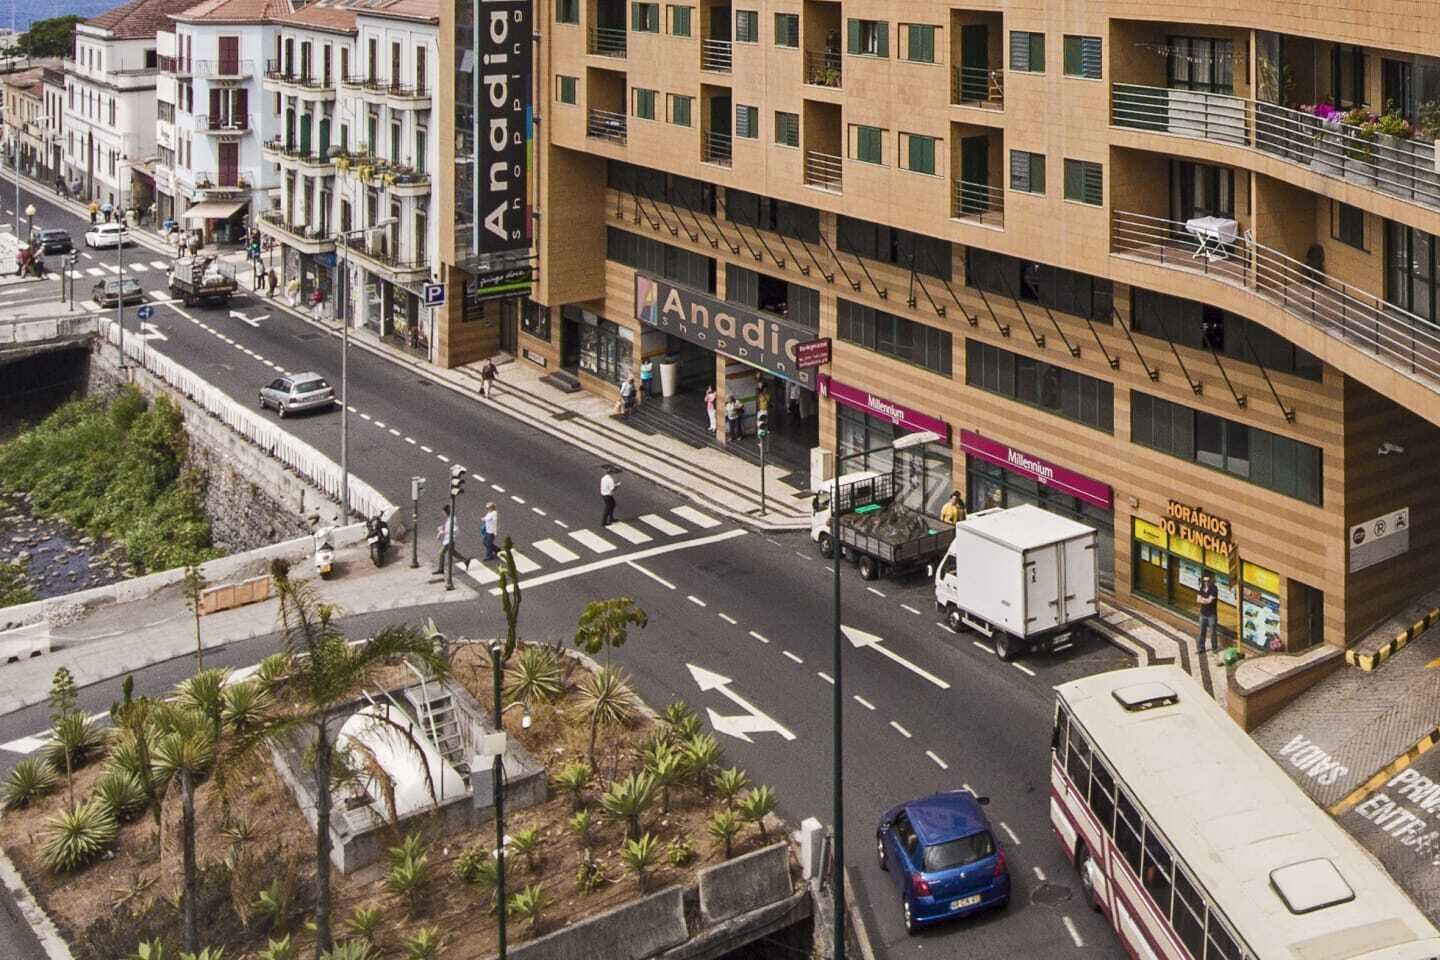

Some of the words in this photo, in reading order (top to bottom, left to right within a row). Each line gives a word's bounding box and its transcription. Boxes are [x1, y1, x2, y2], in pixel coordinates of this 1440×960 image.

[484, 11, 508, 240] Anadia
[428, 286, 441, 301] P
[868, 393, 904, 419] Millennium
[1008, 448, 1053, 478] Millennium
